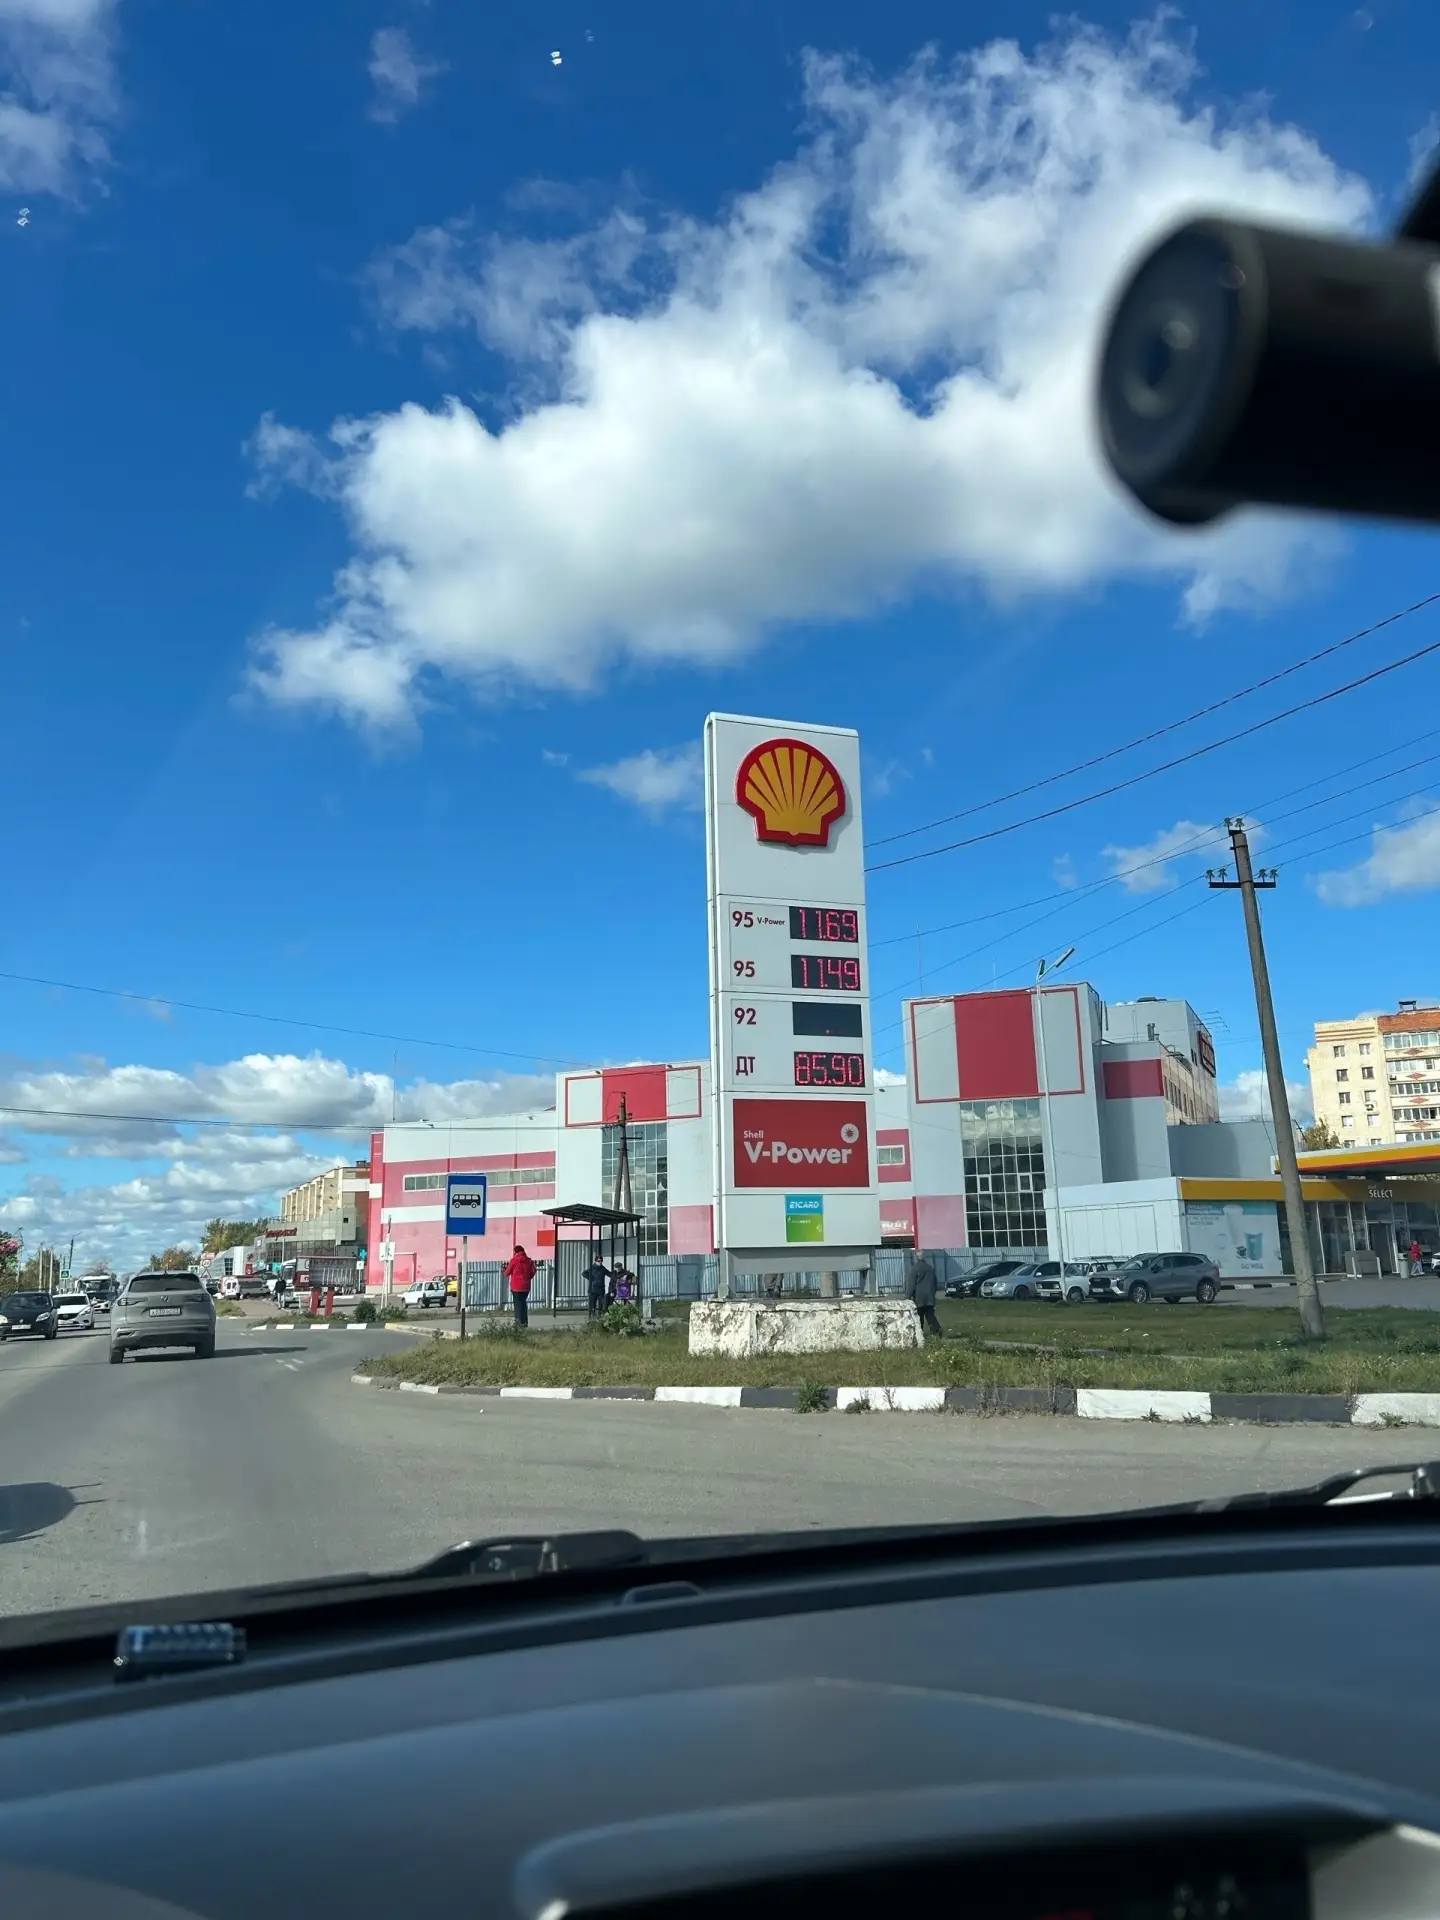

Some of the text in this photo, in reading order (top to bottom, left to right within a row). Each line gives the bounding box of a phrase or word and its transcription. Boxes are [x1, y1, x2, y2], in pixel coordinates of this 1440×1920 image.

[732, 908, 857, 942] 95 V-Power 11.69
[733, 956, 859, 989] 95 11.49
[734, 1007, 757, 1025] 92
[735, 1053, 863, 1085] ДТ 85.90
[743, 1130, 764, 1139] Shell
[743, 1141, 852, 1164] V-Power
[1368, 1189, 1393, 1199] SELECT
